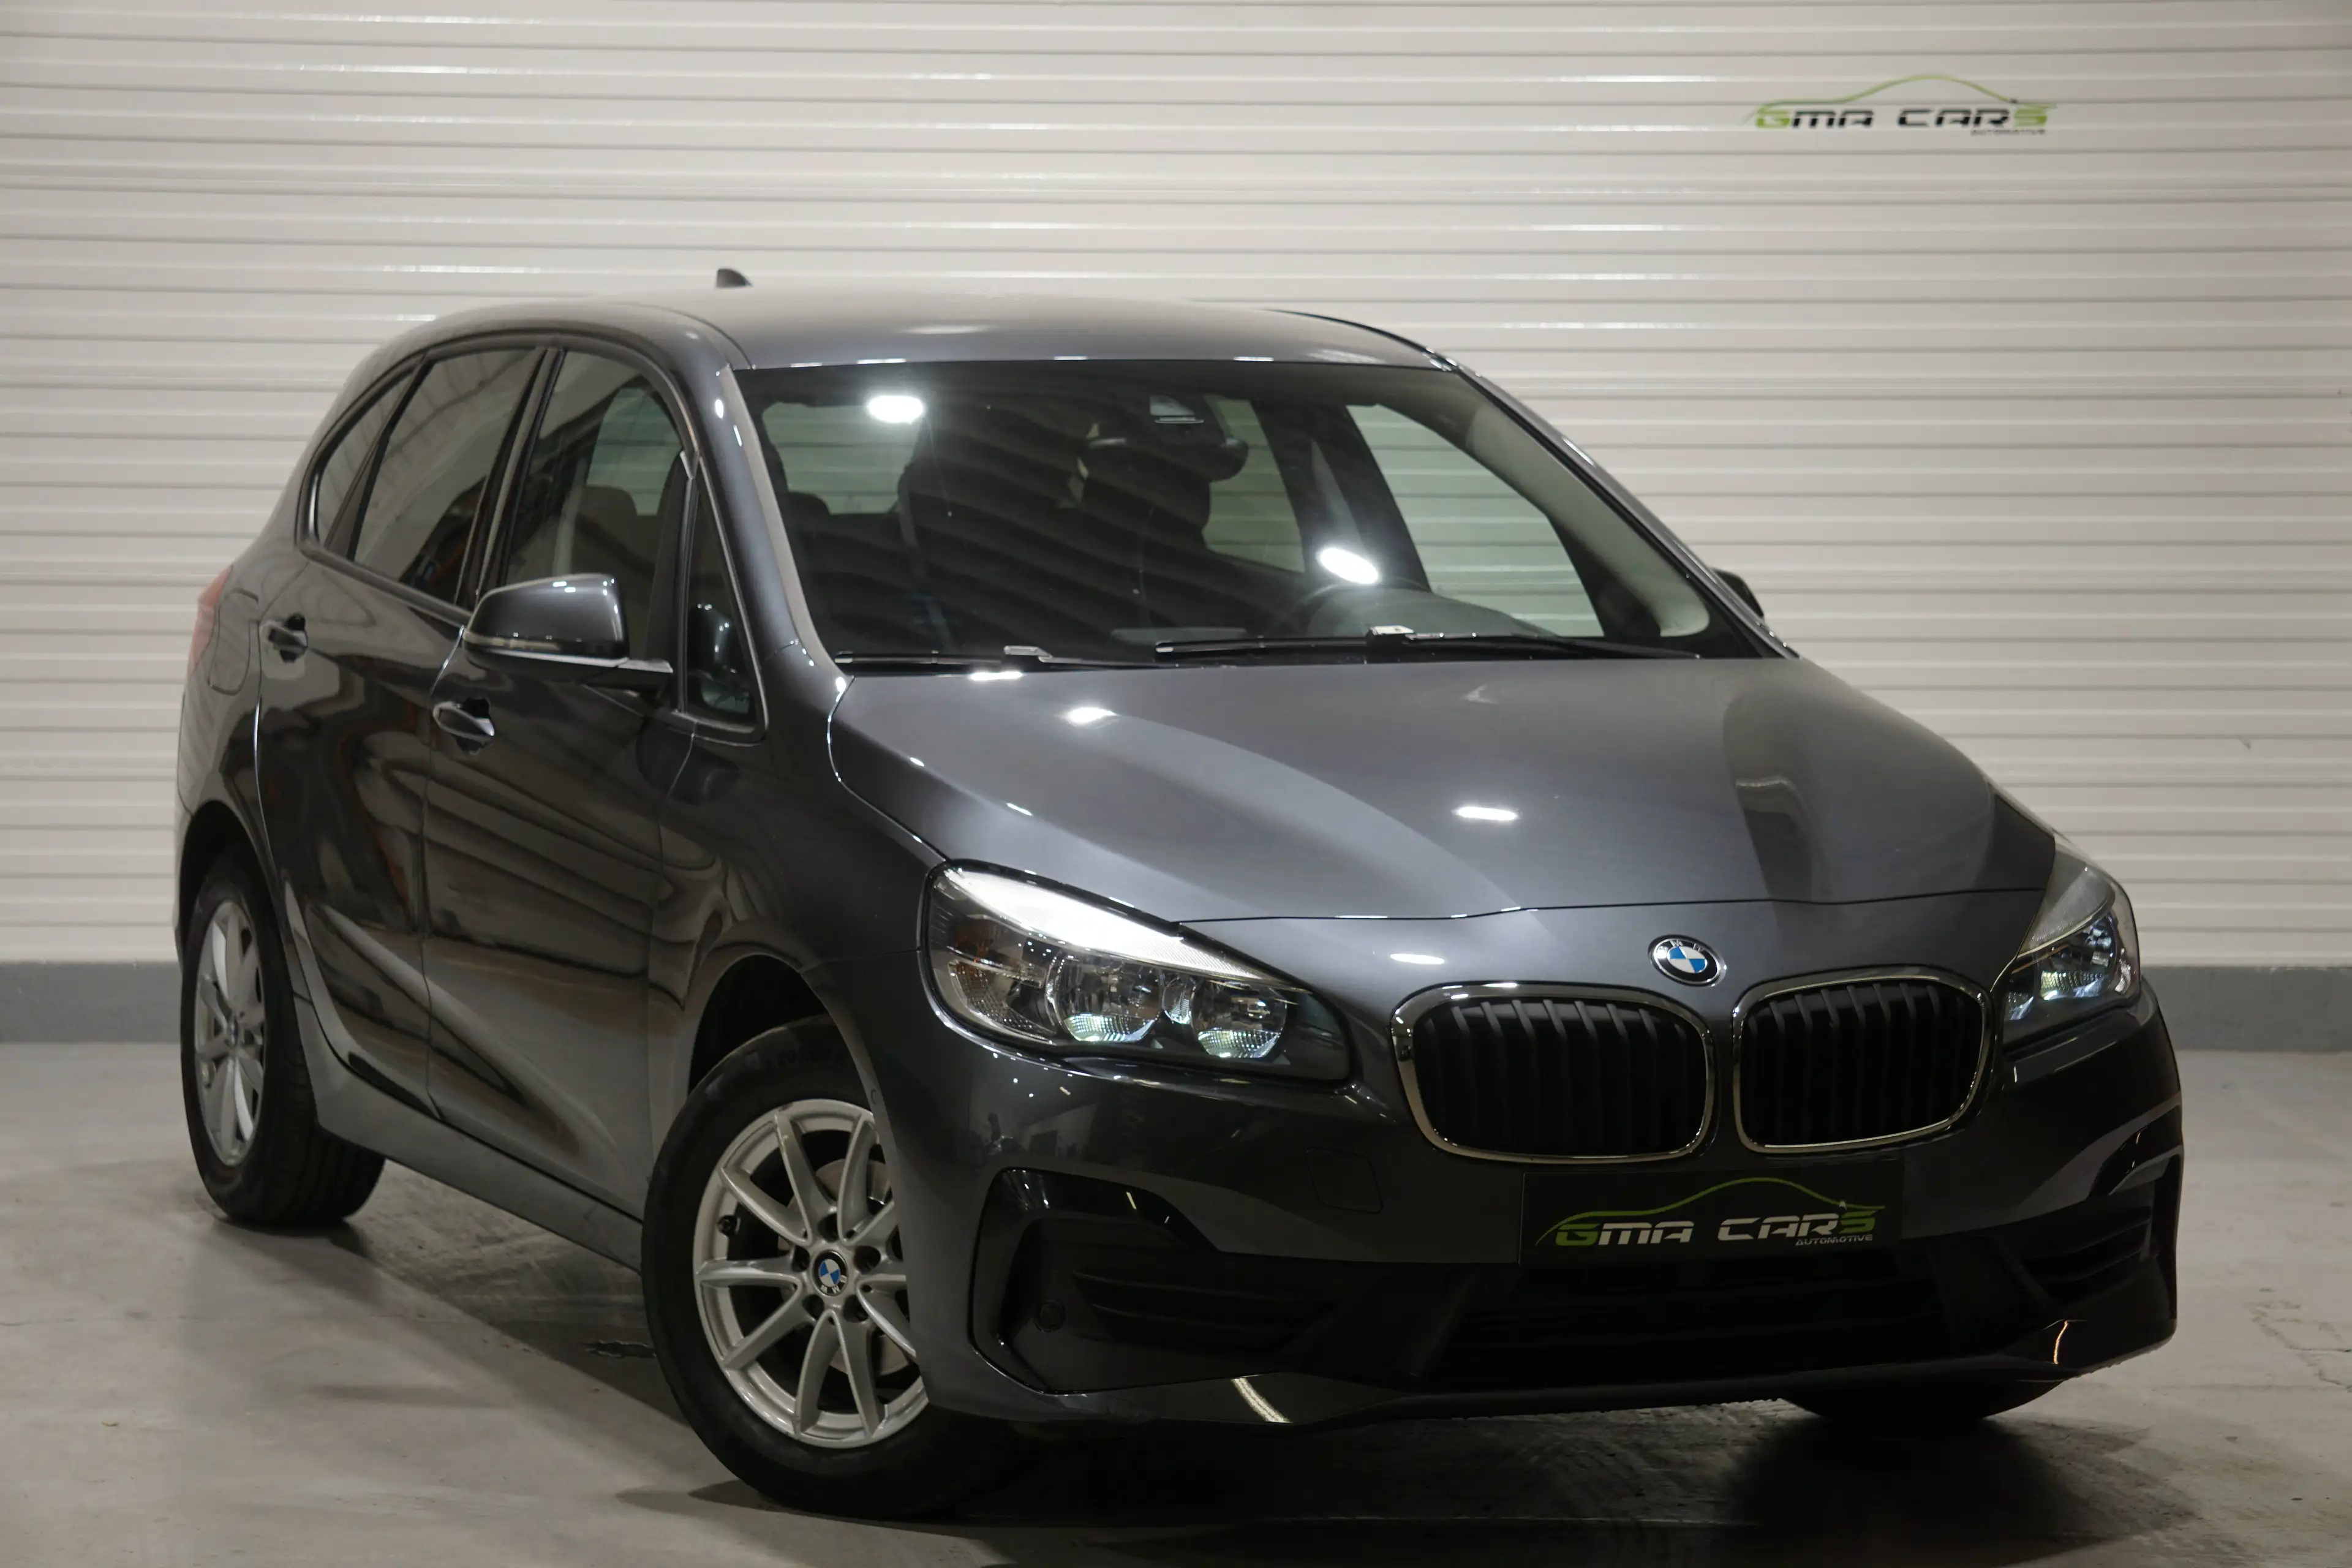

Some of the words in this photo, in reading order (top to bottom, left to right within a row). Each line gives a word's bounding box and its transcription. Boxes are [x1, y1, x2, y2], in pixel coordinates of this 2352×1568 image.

[1755, 108, 1874, 128] GMA
[1898, 107, 2048, 128] CARS
[1556, 1221, 1695, 1246] GMA
[1717, 1210, 1878, 1241] CARS
[1795, 1234, 1873, 1246] AUTOMOTIVE
